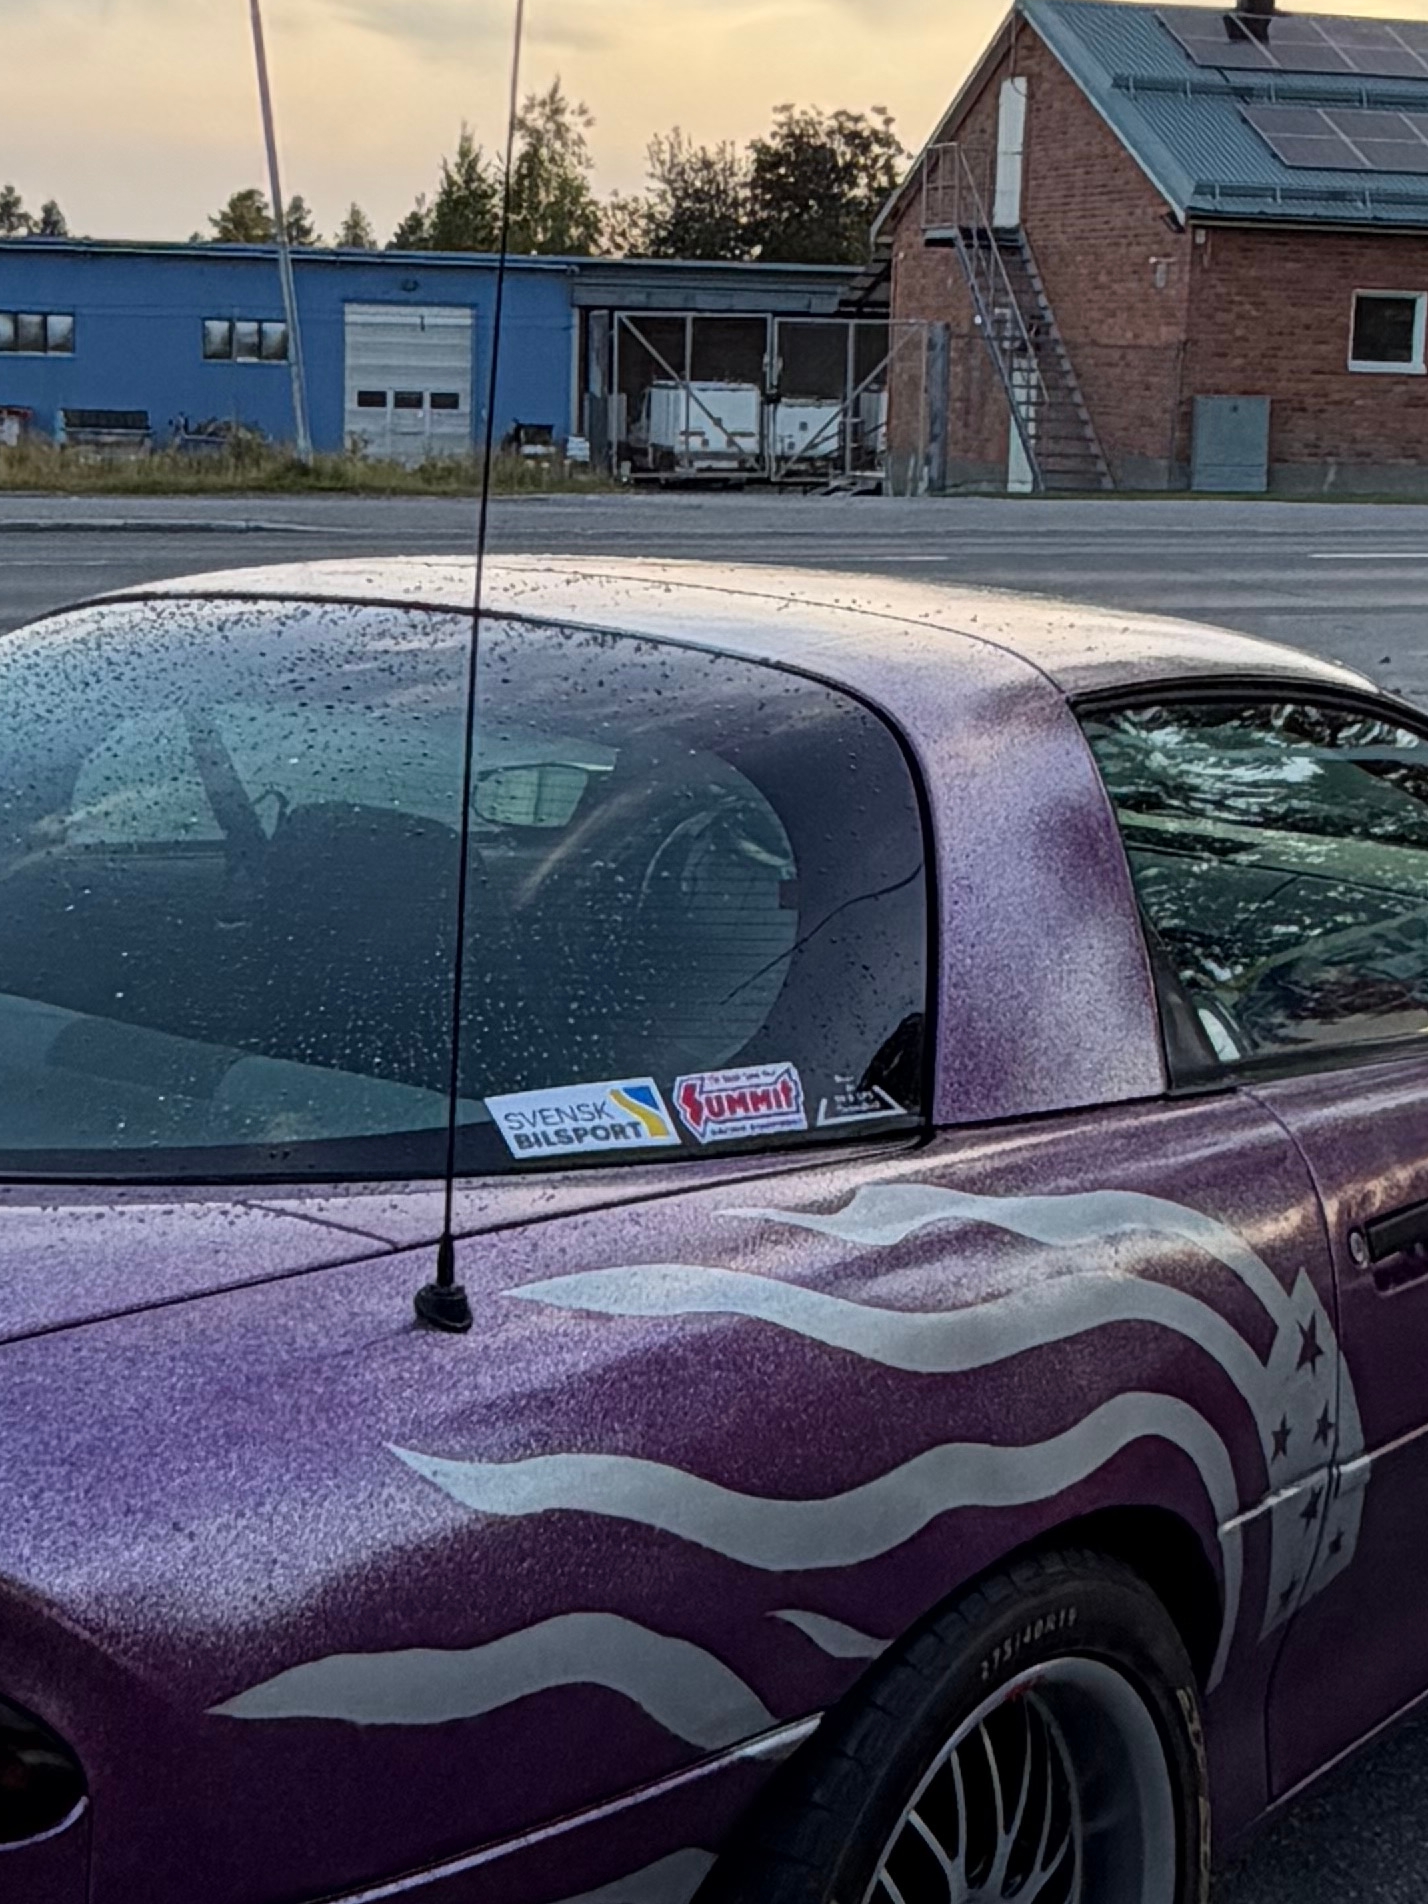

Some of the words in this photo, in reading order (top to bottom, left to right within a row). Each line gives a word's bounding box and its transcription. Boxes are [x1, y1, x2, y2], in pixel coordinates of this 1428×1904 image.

[504, 1099, 613, 1132] SVENSK
[681, 1078, 793, 1128] SUMMIT
[515, 1120, 643, 1151] BILSPORT
